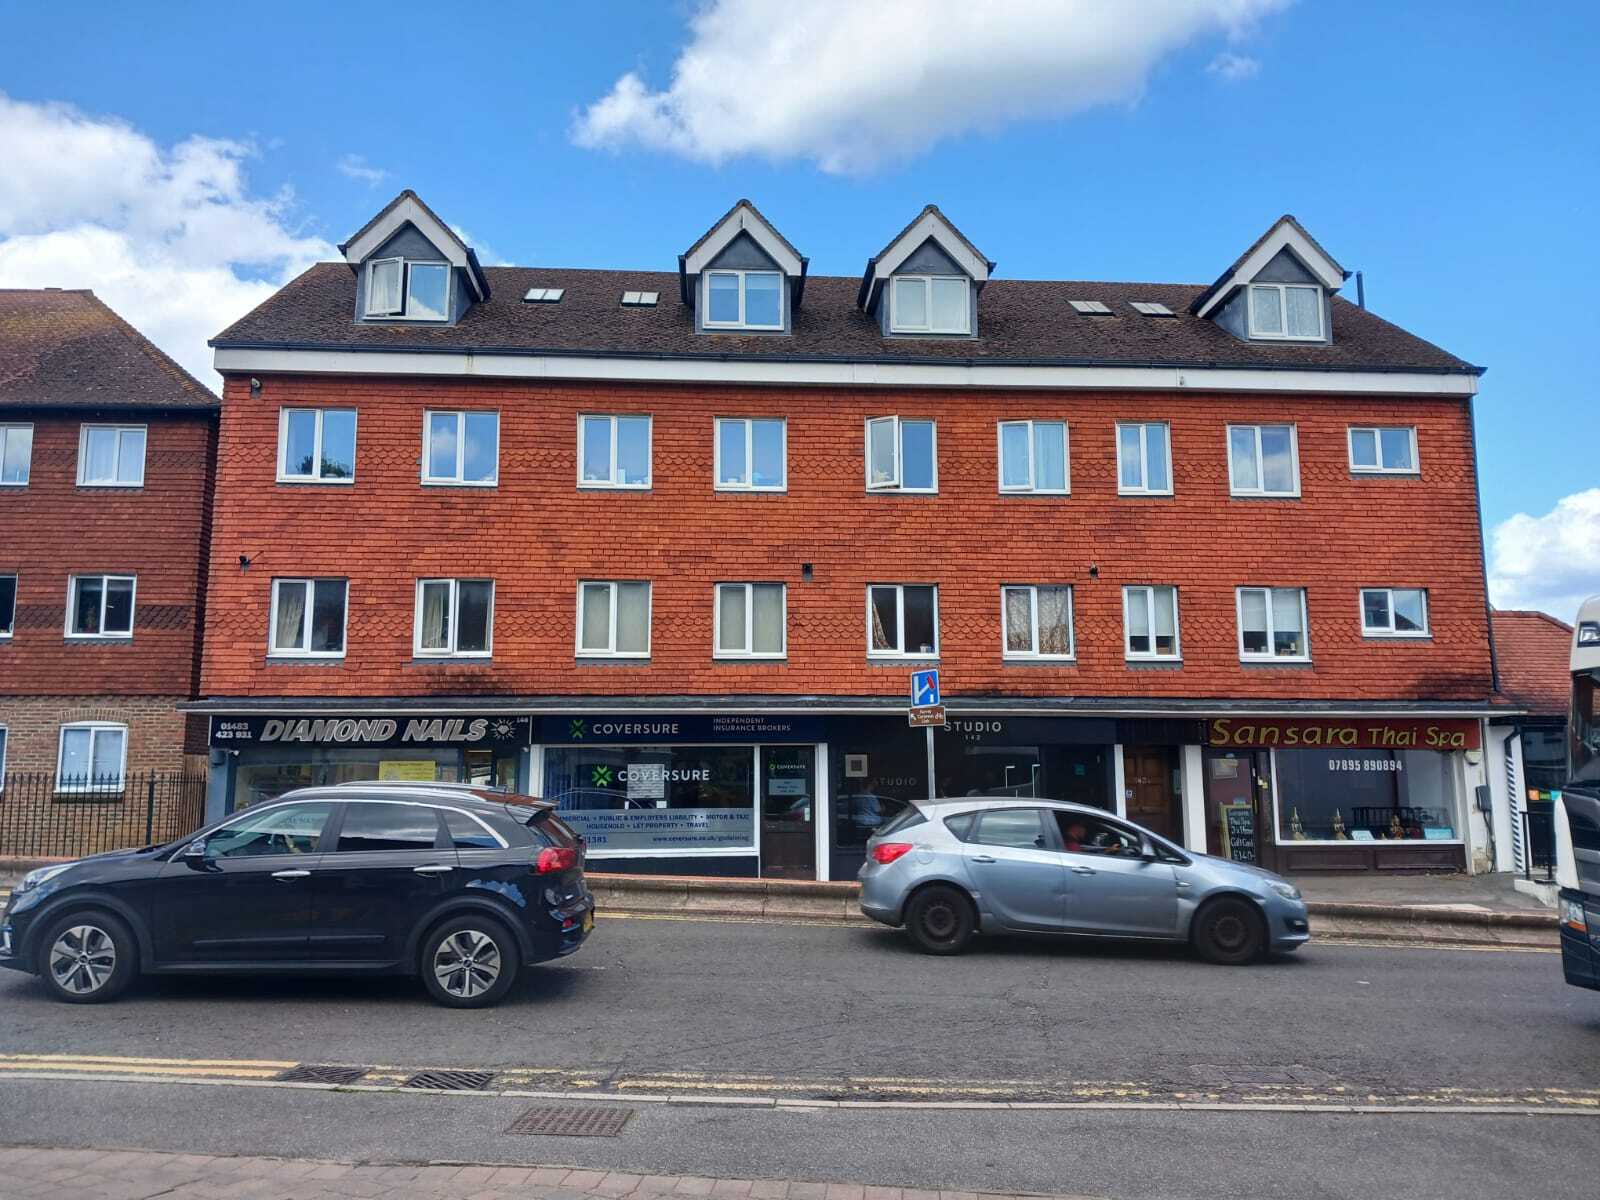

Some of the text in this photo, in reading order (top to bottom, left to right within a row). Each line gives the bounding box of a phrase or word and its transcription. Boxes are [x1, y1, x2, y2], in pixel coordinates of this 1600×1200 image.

[260, 719, 489, 741] DIAMOND NAILS
[592, 723, 679, 735] COVERSURE
[944, 721, 1002, 732] STUDIO
[1209, 719, 1465, 746] Sansara Thai Spa
[1328, 759, 1403, 772] 07895 890894
[617, 770, 711, 781] COVERSURE
